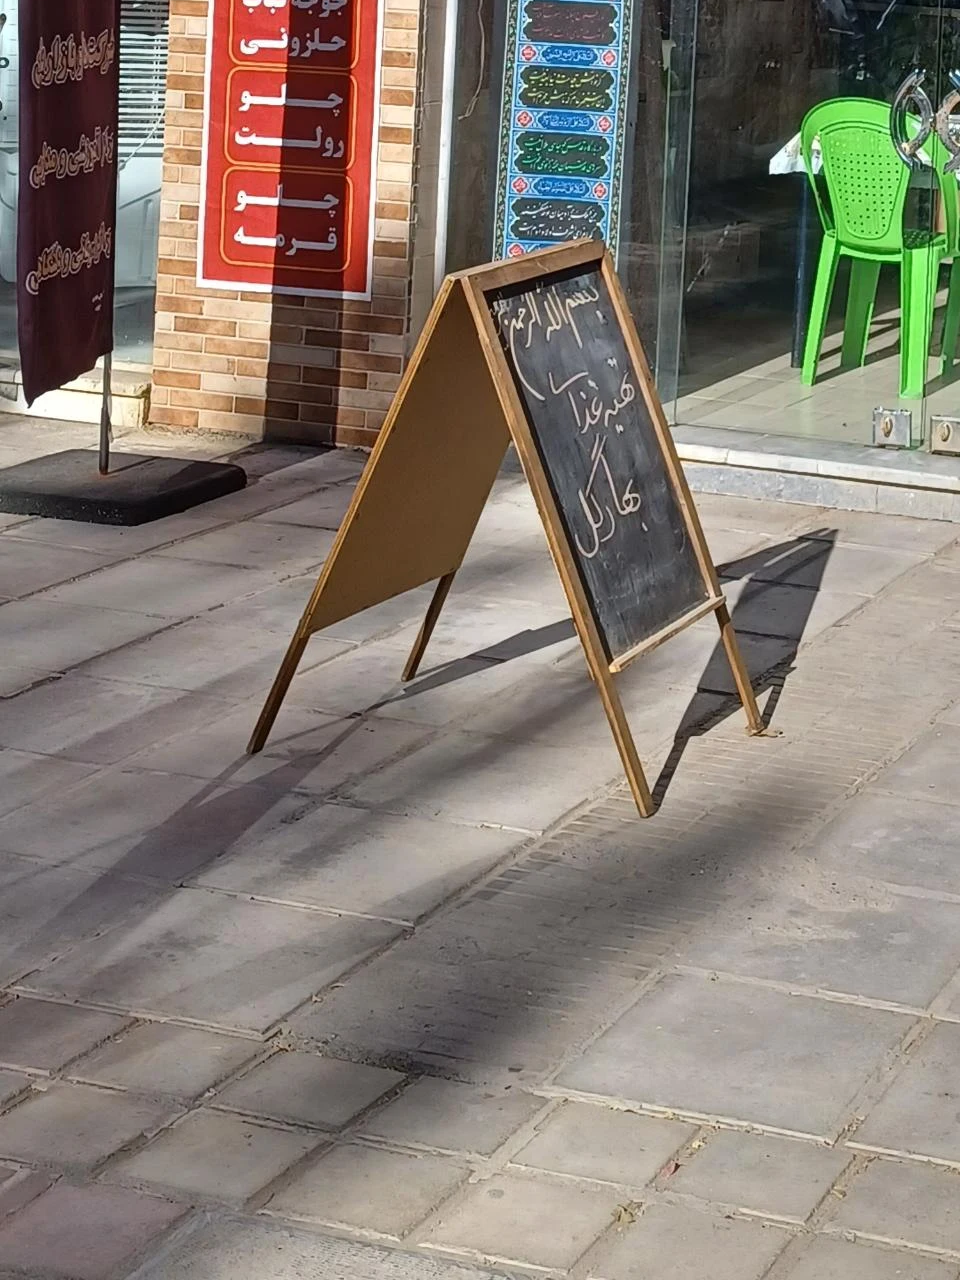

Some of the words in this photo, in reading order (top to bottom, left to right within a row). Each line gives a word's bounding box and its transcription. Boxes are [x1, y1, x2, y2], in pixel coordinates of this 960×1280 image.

[240, 26, 347, 60] حلزونی
[238, 82, 344, 117] چلو
[234, 126, 346, 158] رولت
[234, 183, 340, 219] چلو
[233, 227, 338, 257] قرمه
[602, 357, 637, 434] تهیه
